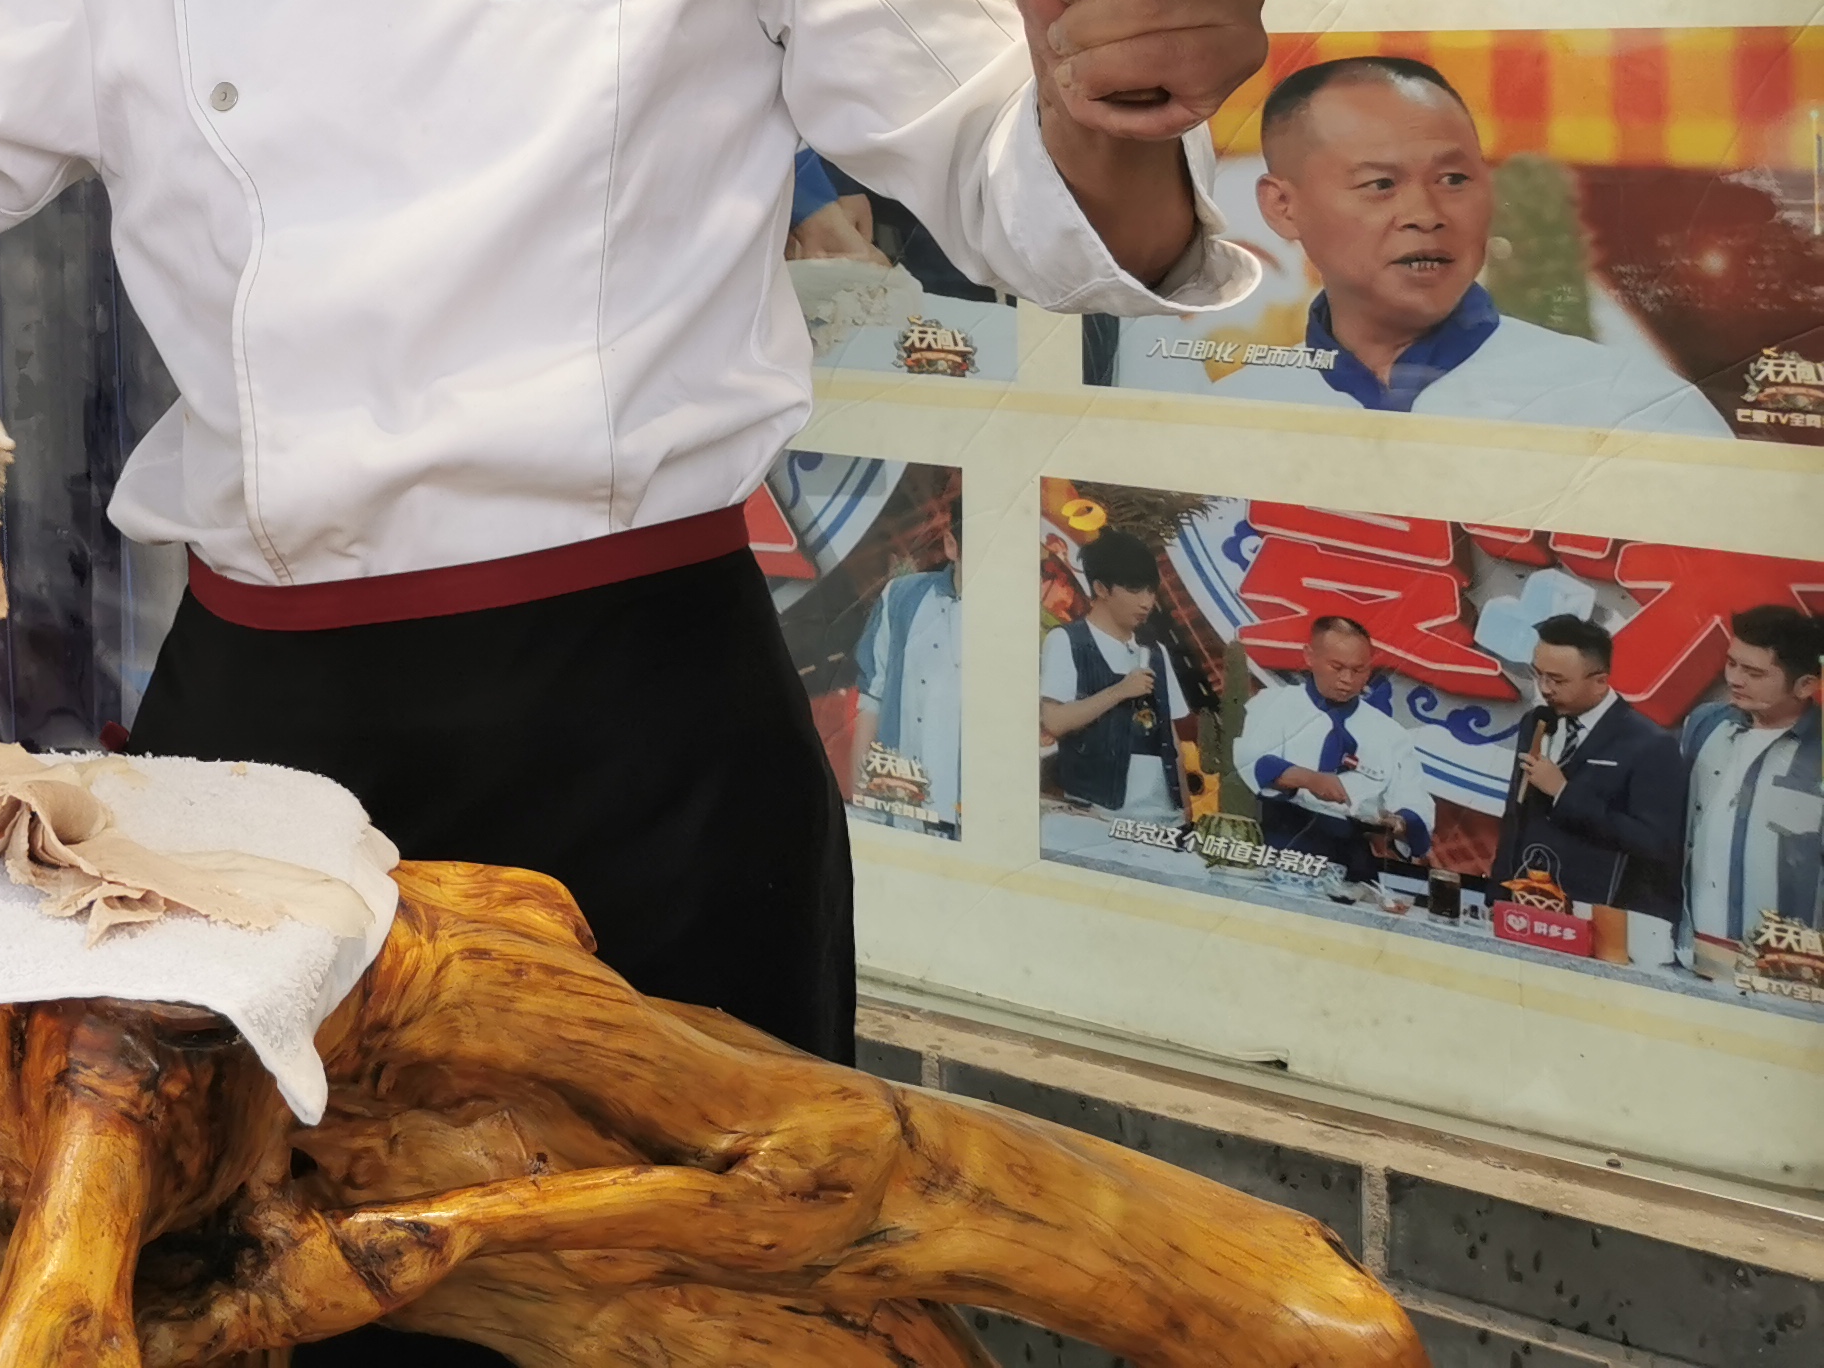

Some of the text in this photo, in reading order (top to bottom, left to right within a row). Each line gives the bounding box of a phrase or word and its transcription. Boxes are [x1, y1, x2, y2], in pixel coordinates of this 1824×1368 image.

[1146, 337, 1340, 371] 入口即化 肥而不腻
[1108, 816, 1332, 878] 感觉这个味道非常好
